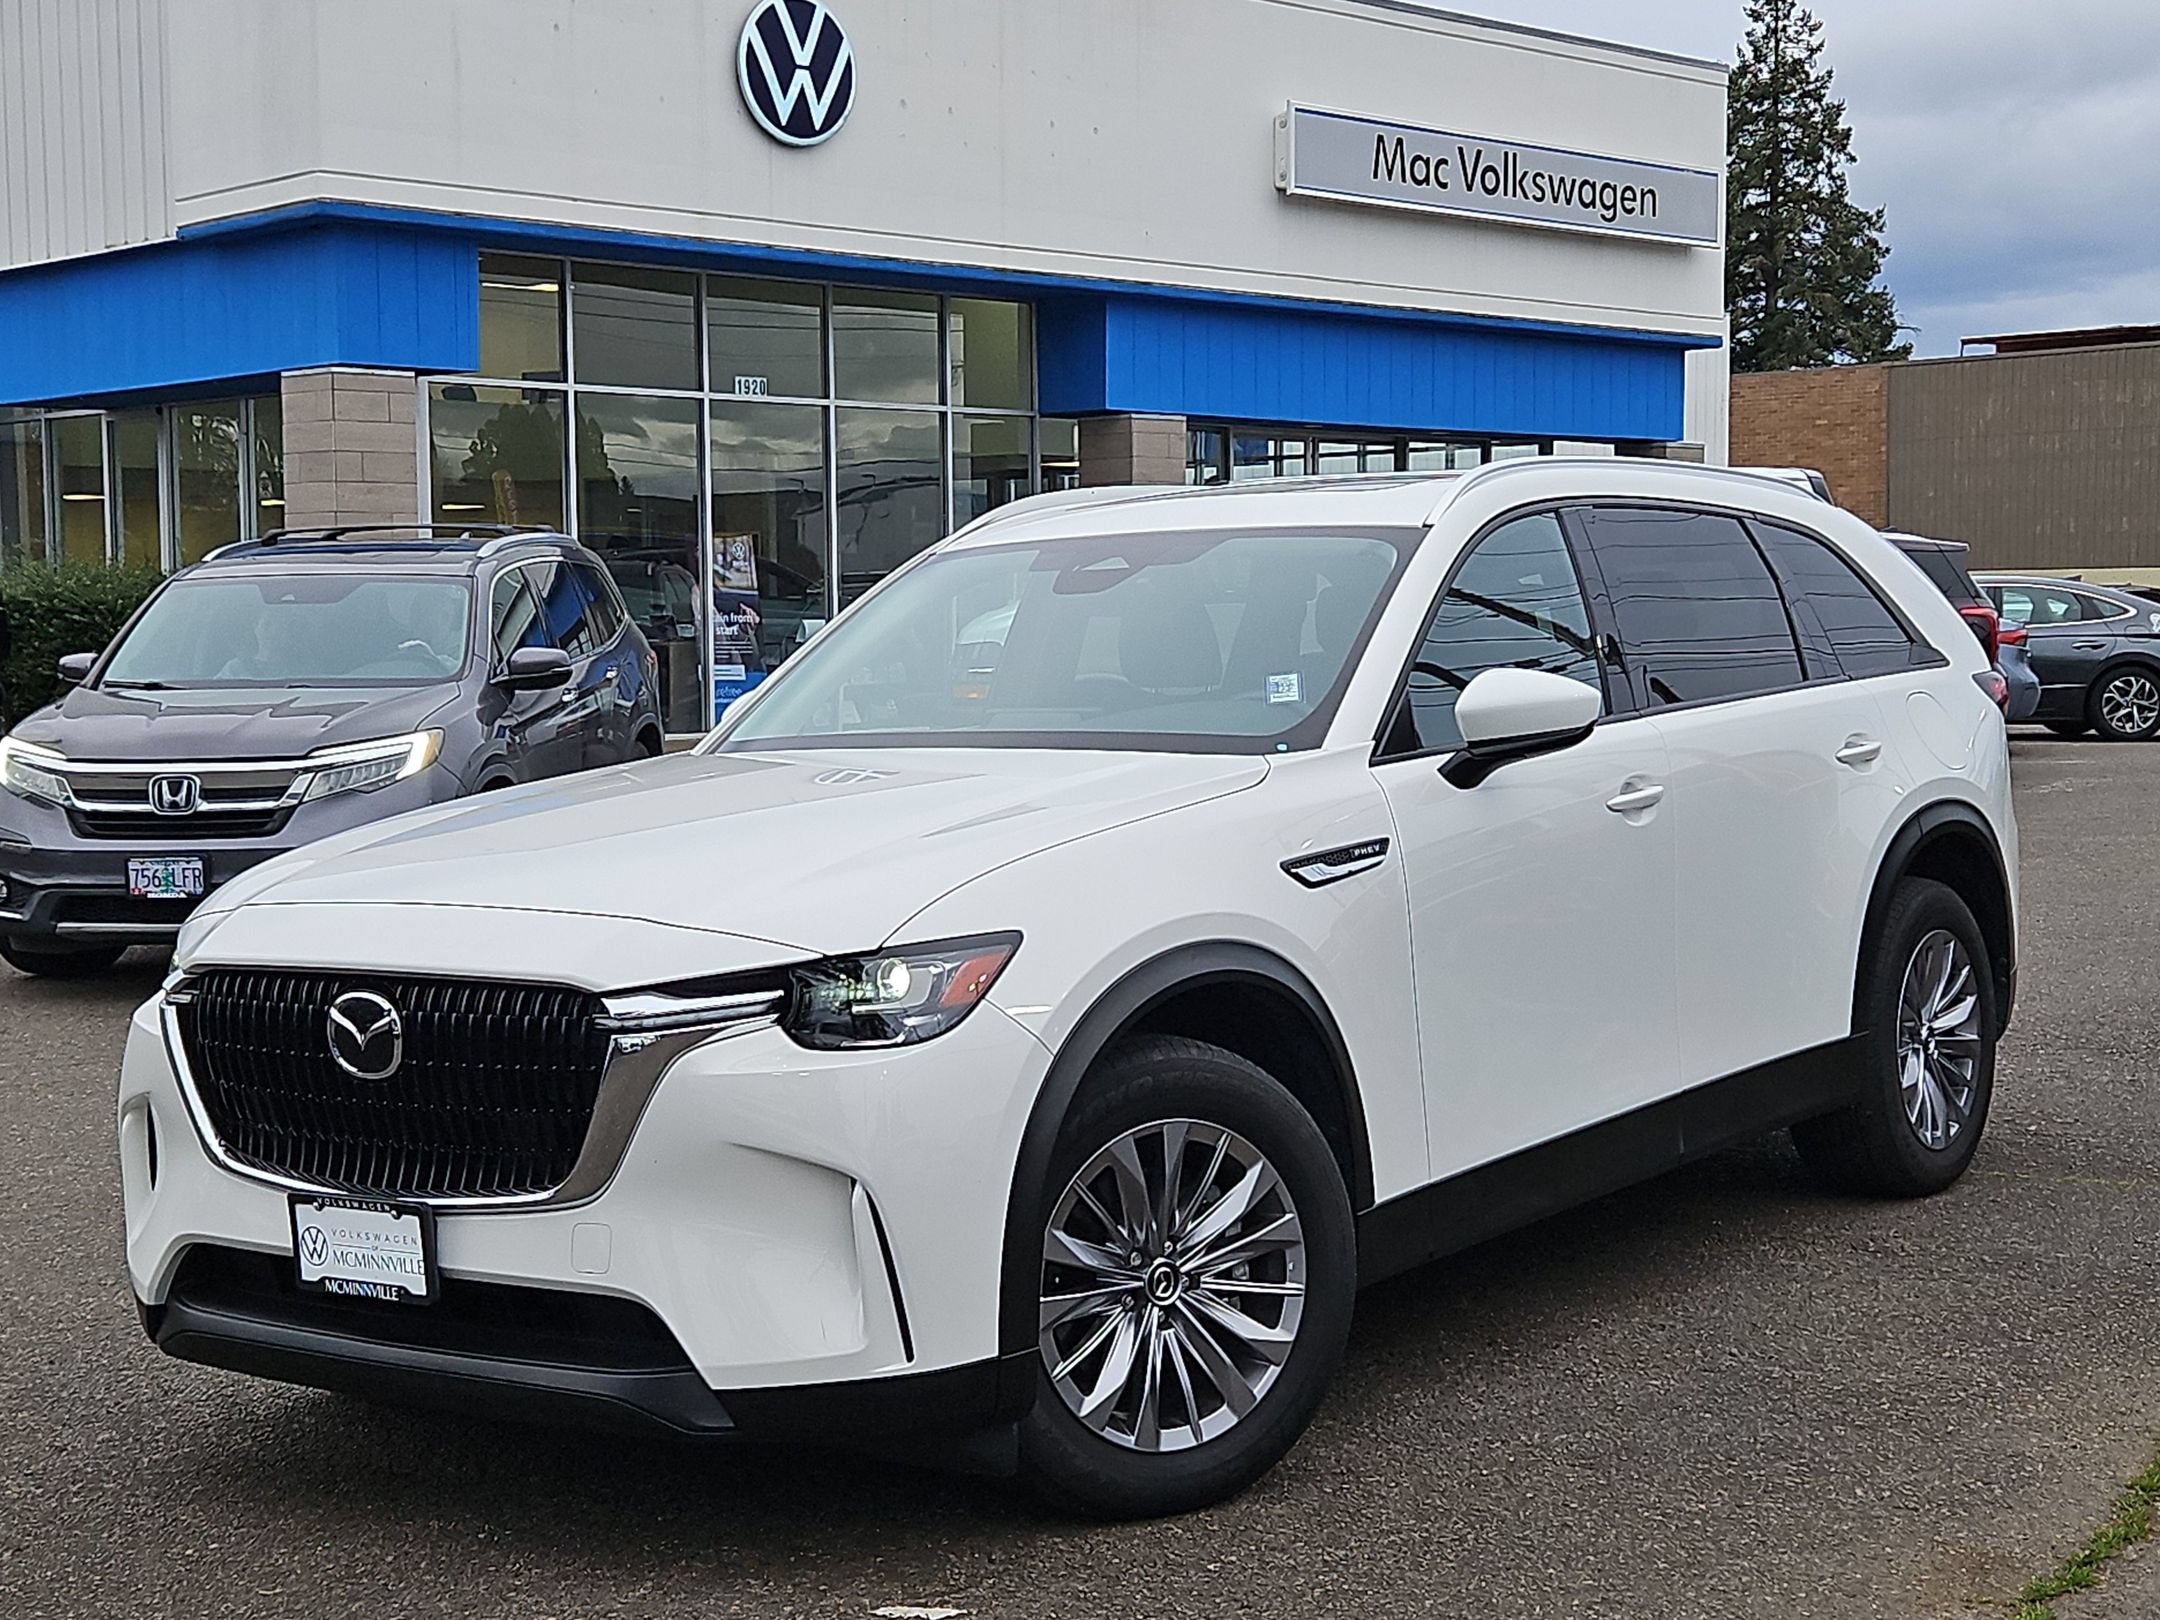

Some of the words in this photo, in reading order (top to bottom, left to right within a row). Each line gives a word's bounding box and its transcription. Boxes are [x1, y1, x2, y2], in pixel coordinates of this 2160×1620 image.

[1371, 134, 1449, 190] Mac
[1457, 146, 1658, 222] Volkswagen
[737, 379, 766, 395] 1920
[1354, 844, 1380, 857] PHEV
[130, 867, 161, 889] 756
[172, 867, 203, 889] LFR
[316, 1197, 390, 1212] VOLKSWAGEN
[331, 1228, 417, 1246] VOLKSWAGEN
[332, 1249, 425, 1276] MCMINNVILLE
[325, 1279, 399, 1301] MCMINNVILLE
